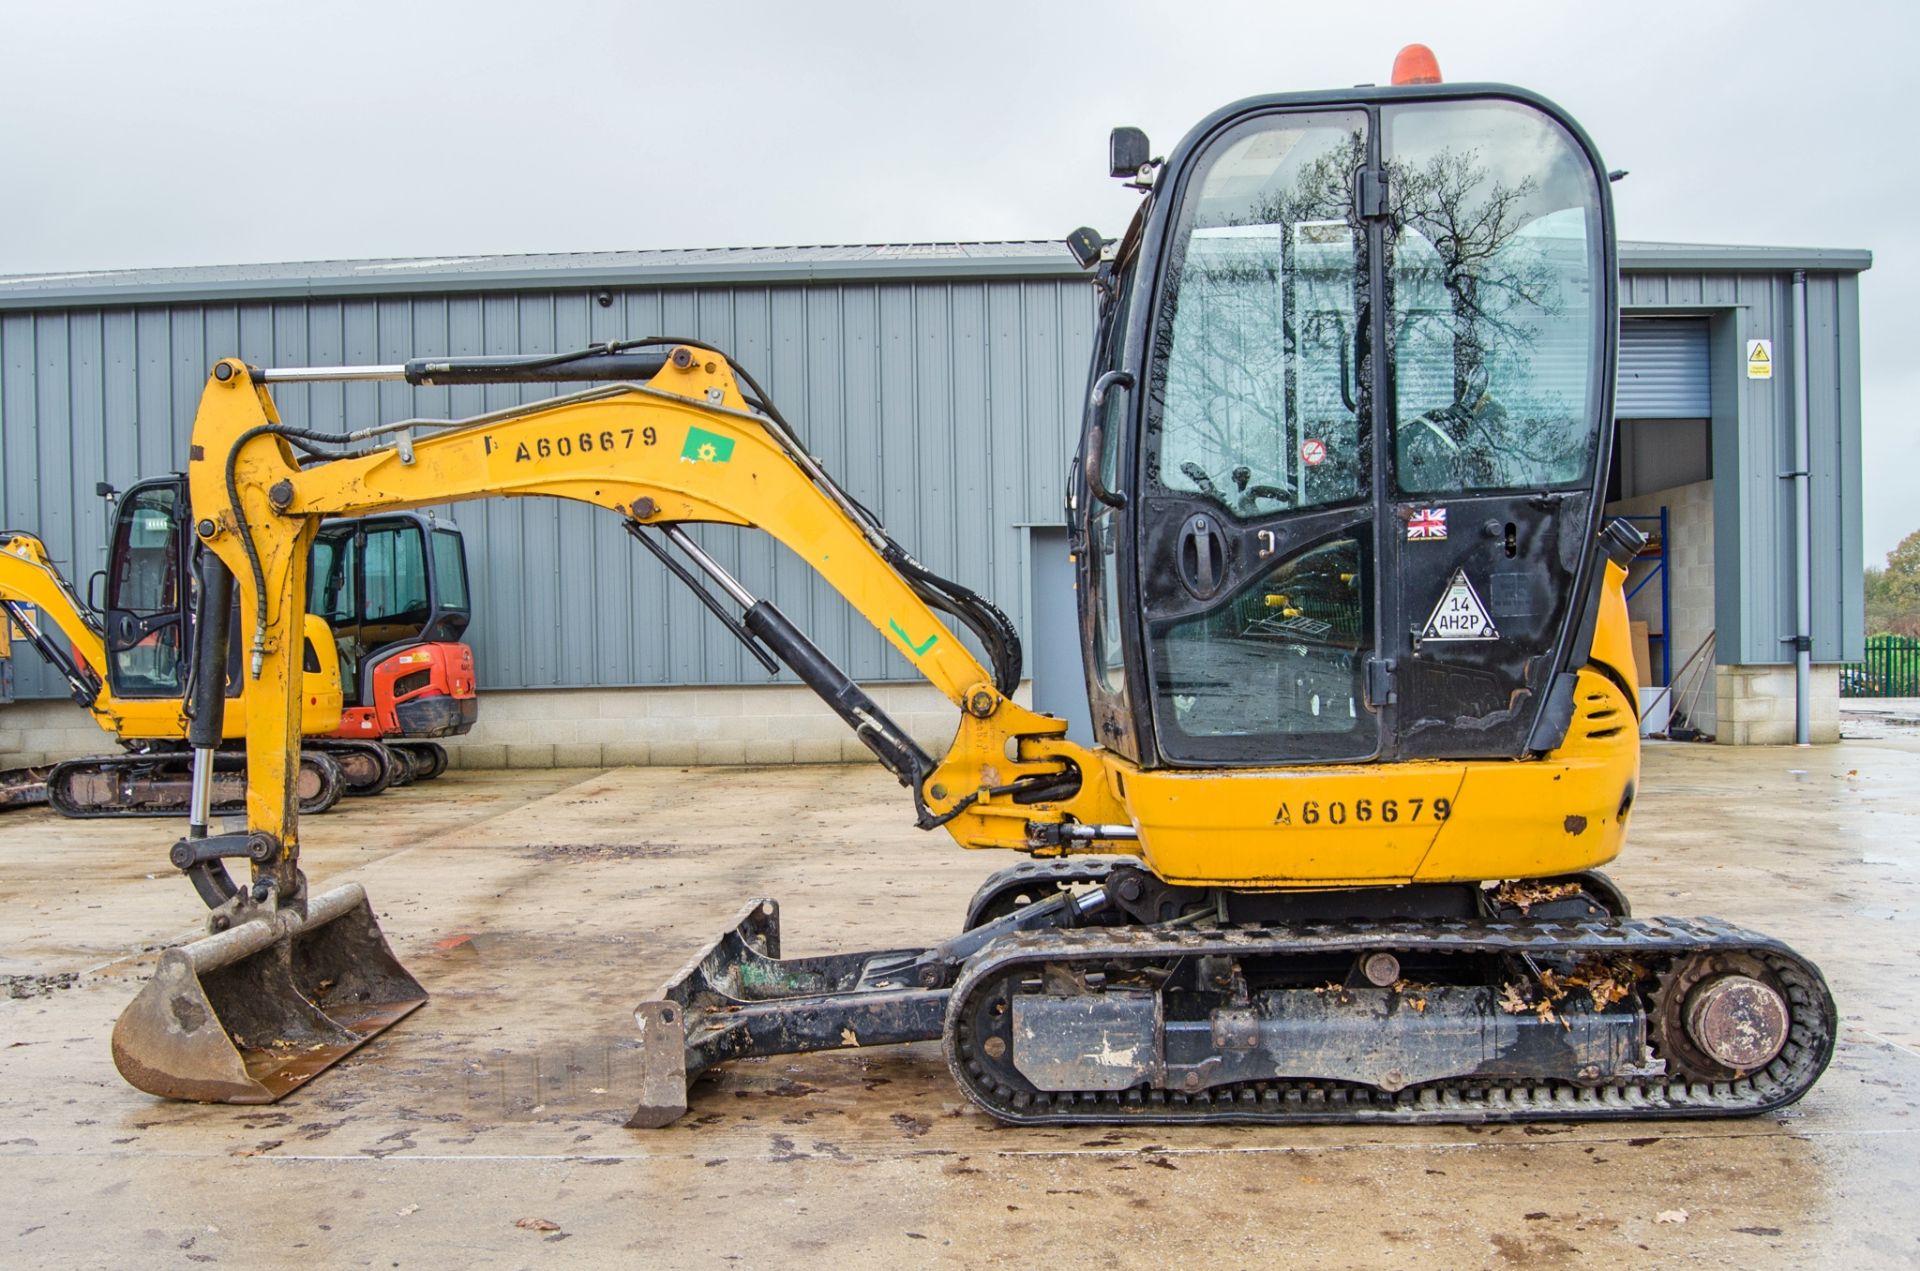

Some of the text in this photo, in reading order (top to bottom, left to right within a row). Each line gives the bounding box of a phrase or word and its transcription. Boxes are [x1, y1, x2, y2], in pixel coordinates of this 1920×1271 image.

[515, 426, 658, 463] A606679
[1451, 597, 1469, 612] 14
[1440, 615, 1479, 629] AH2P
[1274, 798, 1452, 825] A606679
